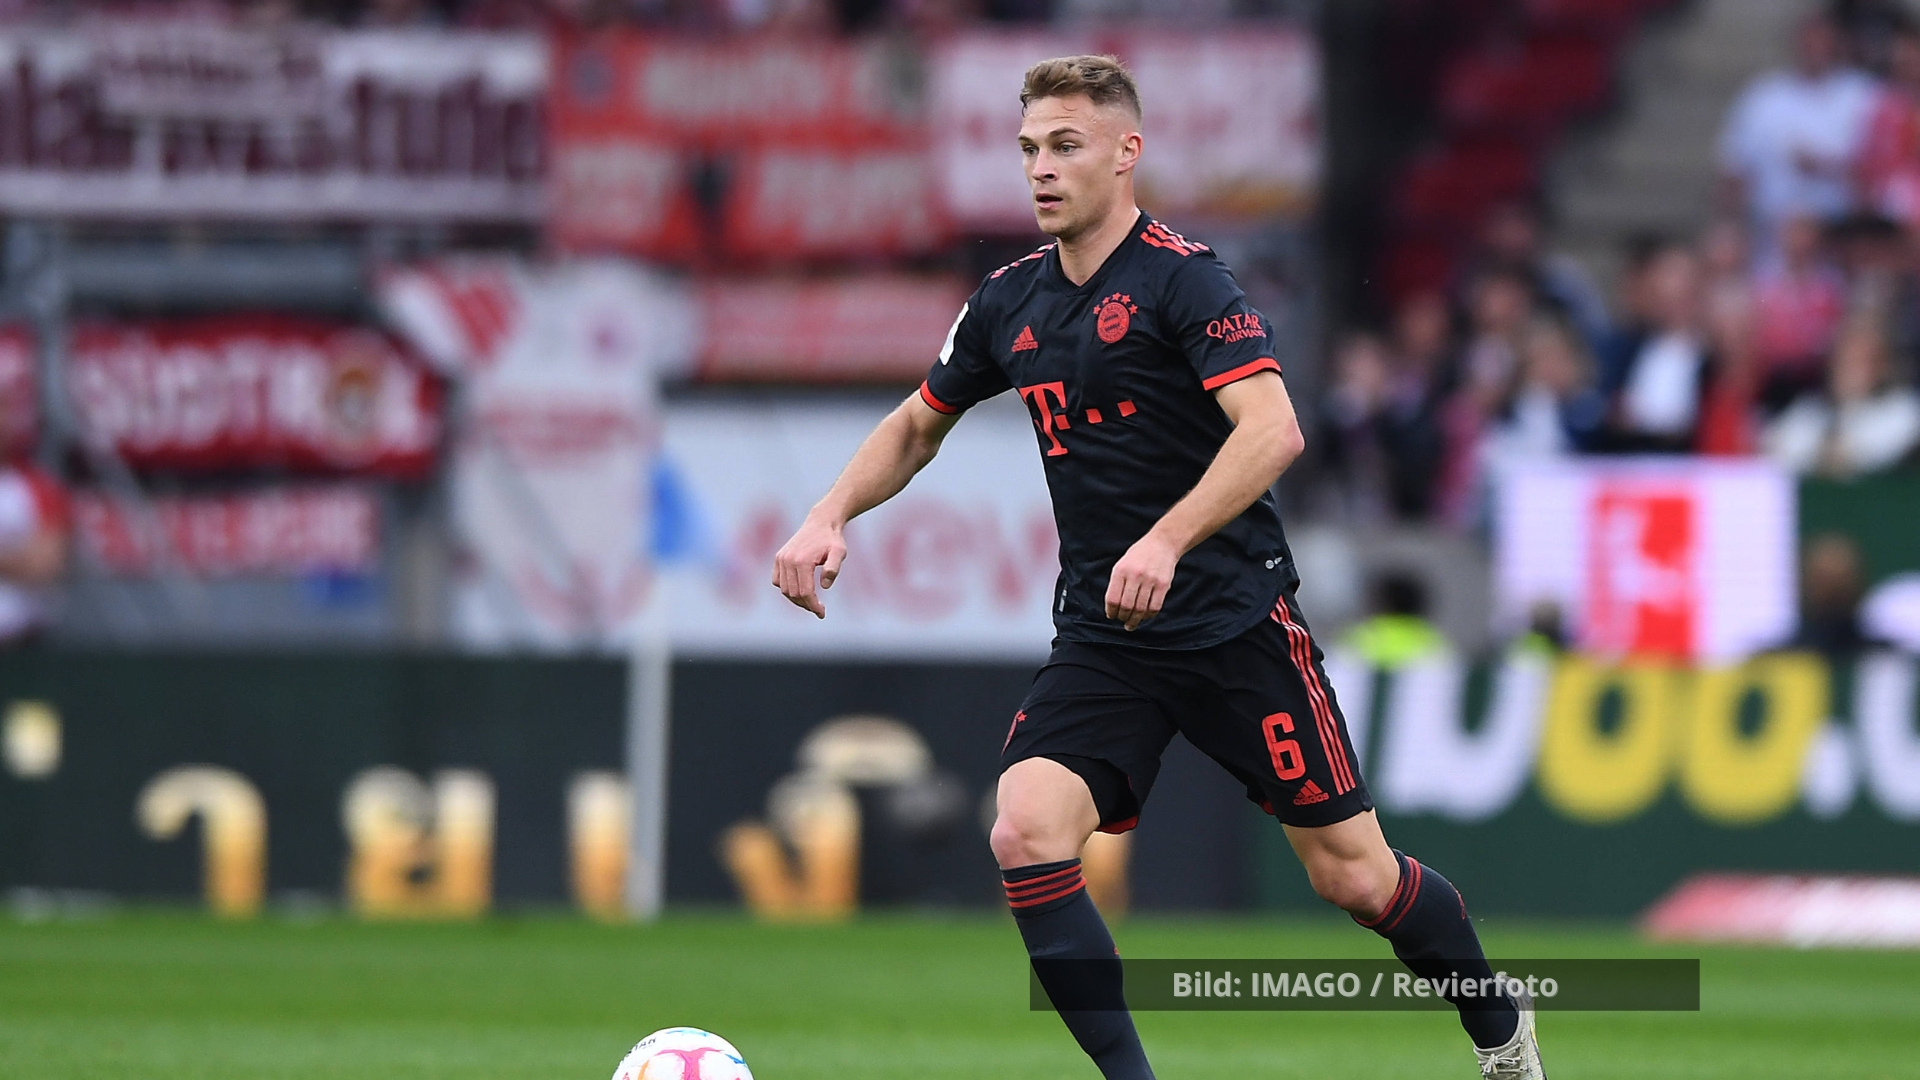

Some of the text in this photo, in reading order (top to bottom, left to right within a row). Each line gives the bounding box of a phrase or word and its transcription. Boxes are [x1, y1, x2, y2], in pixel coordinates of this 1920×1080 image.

[1206, 313, 1262, 339] QATAR
[1225, 328, 1266, 344] AIRWAYS
[1262, 712, 1306, 780] 6
